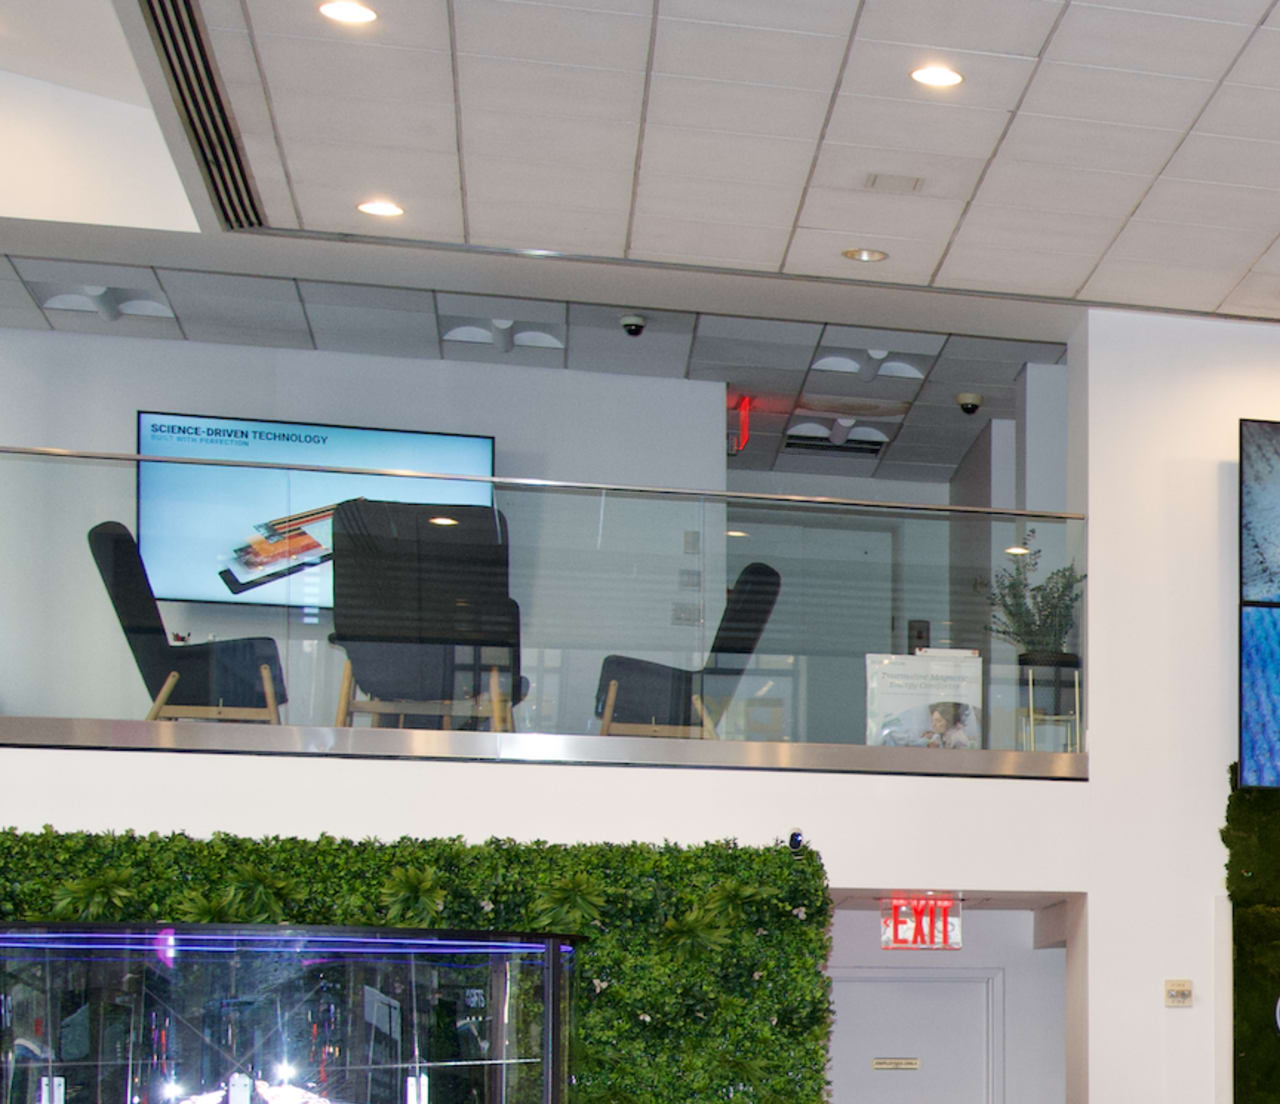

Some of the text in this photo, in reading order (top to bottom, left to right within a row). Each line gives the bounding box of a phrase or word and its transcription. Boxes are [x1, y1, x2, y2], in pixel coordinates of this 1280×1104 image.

[151, 423, 328, 445] SCIENCE-DRIVEN TECHNOLOGY
[892, 898, 954, 945] EXIT
